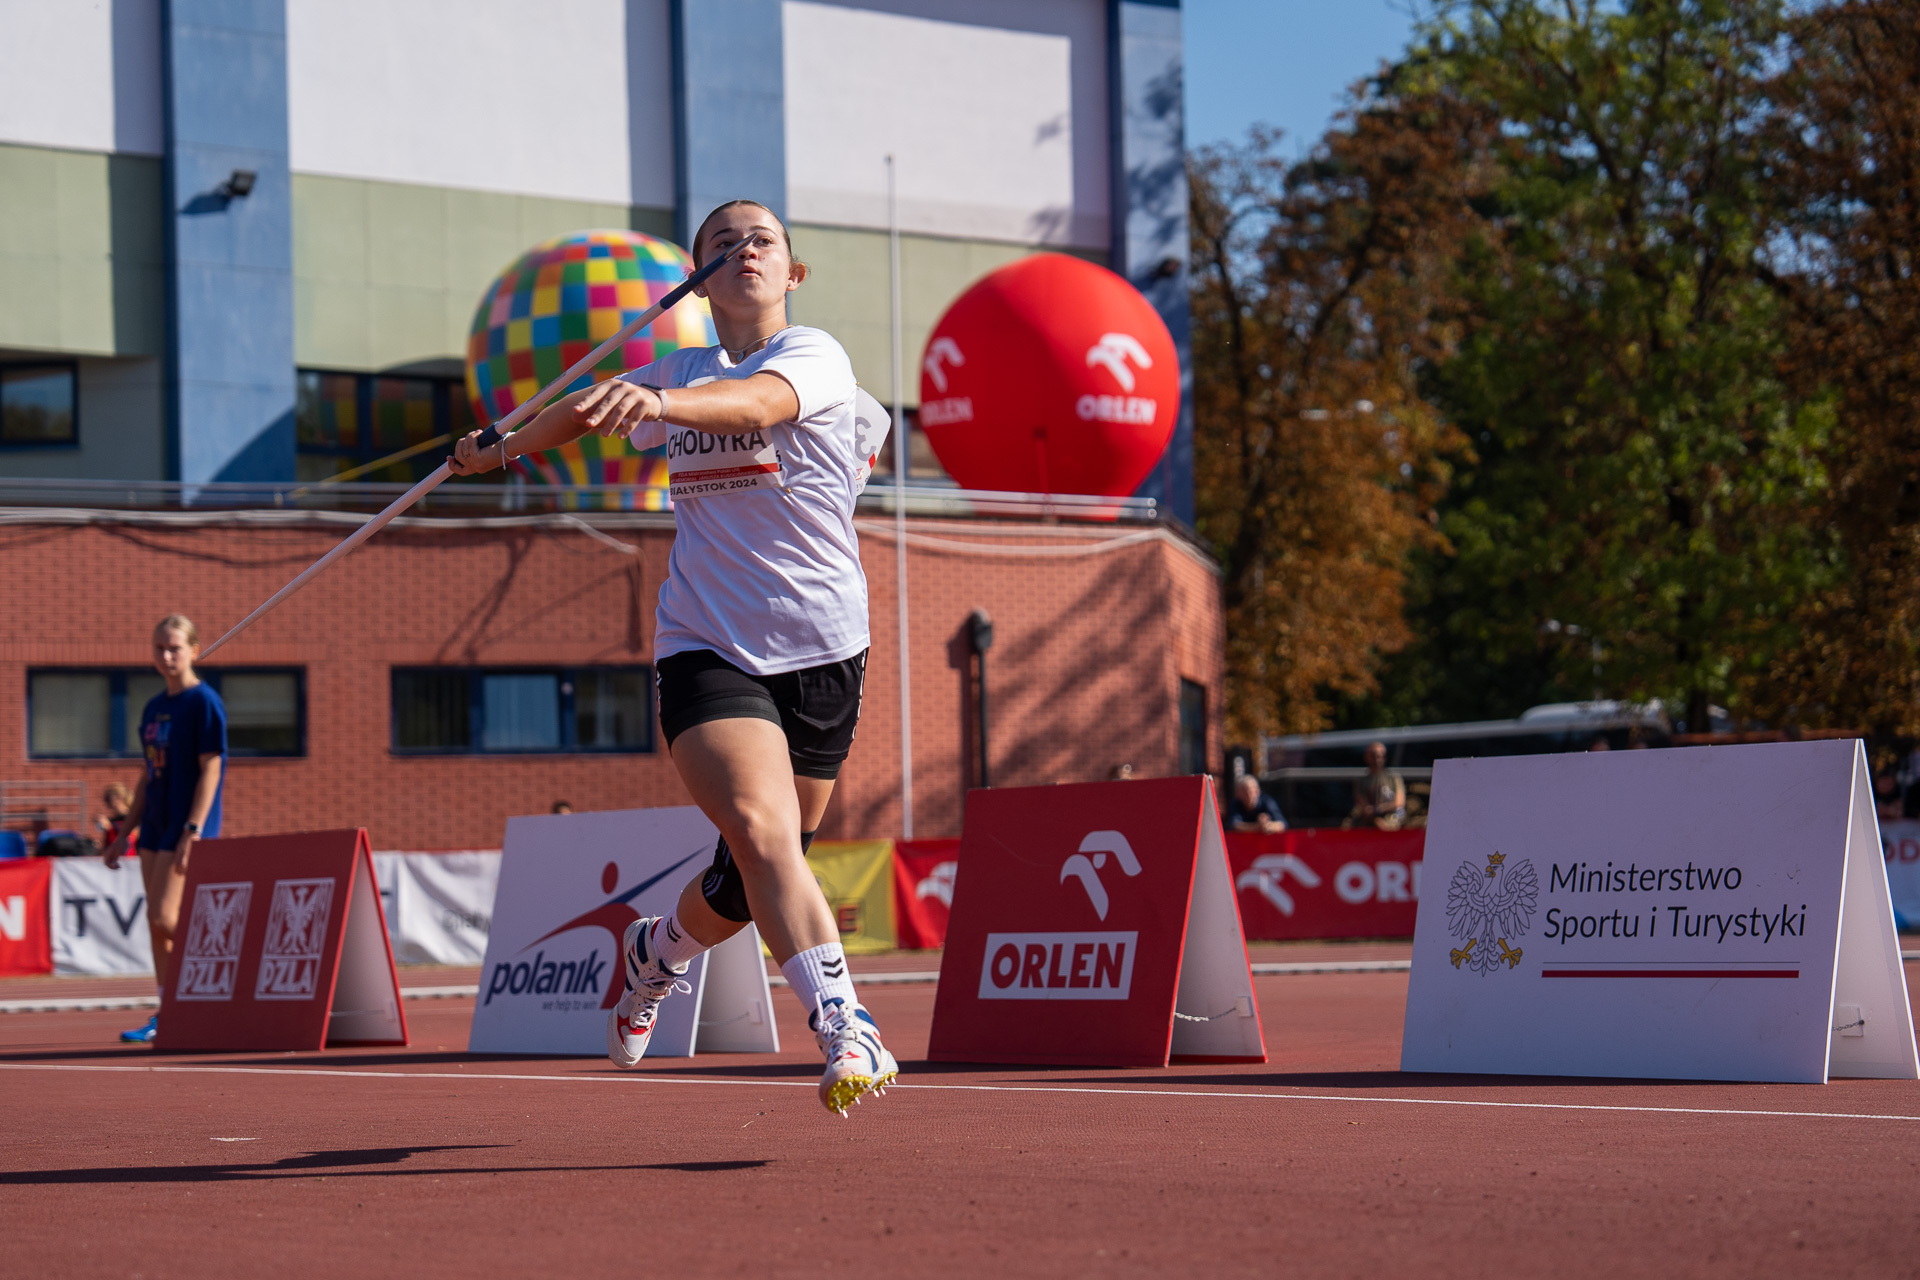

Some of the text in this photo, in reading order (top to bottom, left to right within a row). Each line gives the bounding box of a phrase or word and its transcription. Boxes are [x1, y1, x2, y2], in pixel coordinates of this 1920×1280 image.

[1076, 394, 1157, 425] ORLEN
[668, 430, 768, 460] CHODYRA
[729, 478, 758, 489] 2024
[1550, 861, 1743, 893] Ministerstwo
[1543, 904, 1807, 945] Sportu i Turystyki
[178, 960, 231, 993] PZLA
[258, 959, 312, 992] PZLA
[484, 949, 607, 1006] polanik
[990, 942, 1127, 989] ORLEN
[542, 1000, 553, 1010] we
[556, 999, 571, 1012] help
